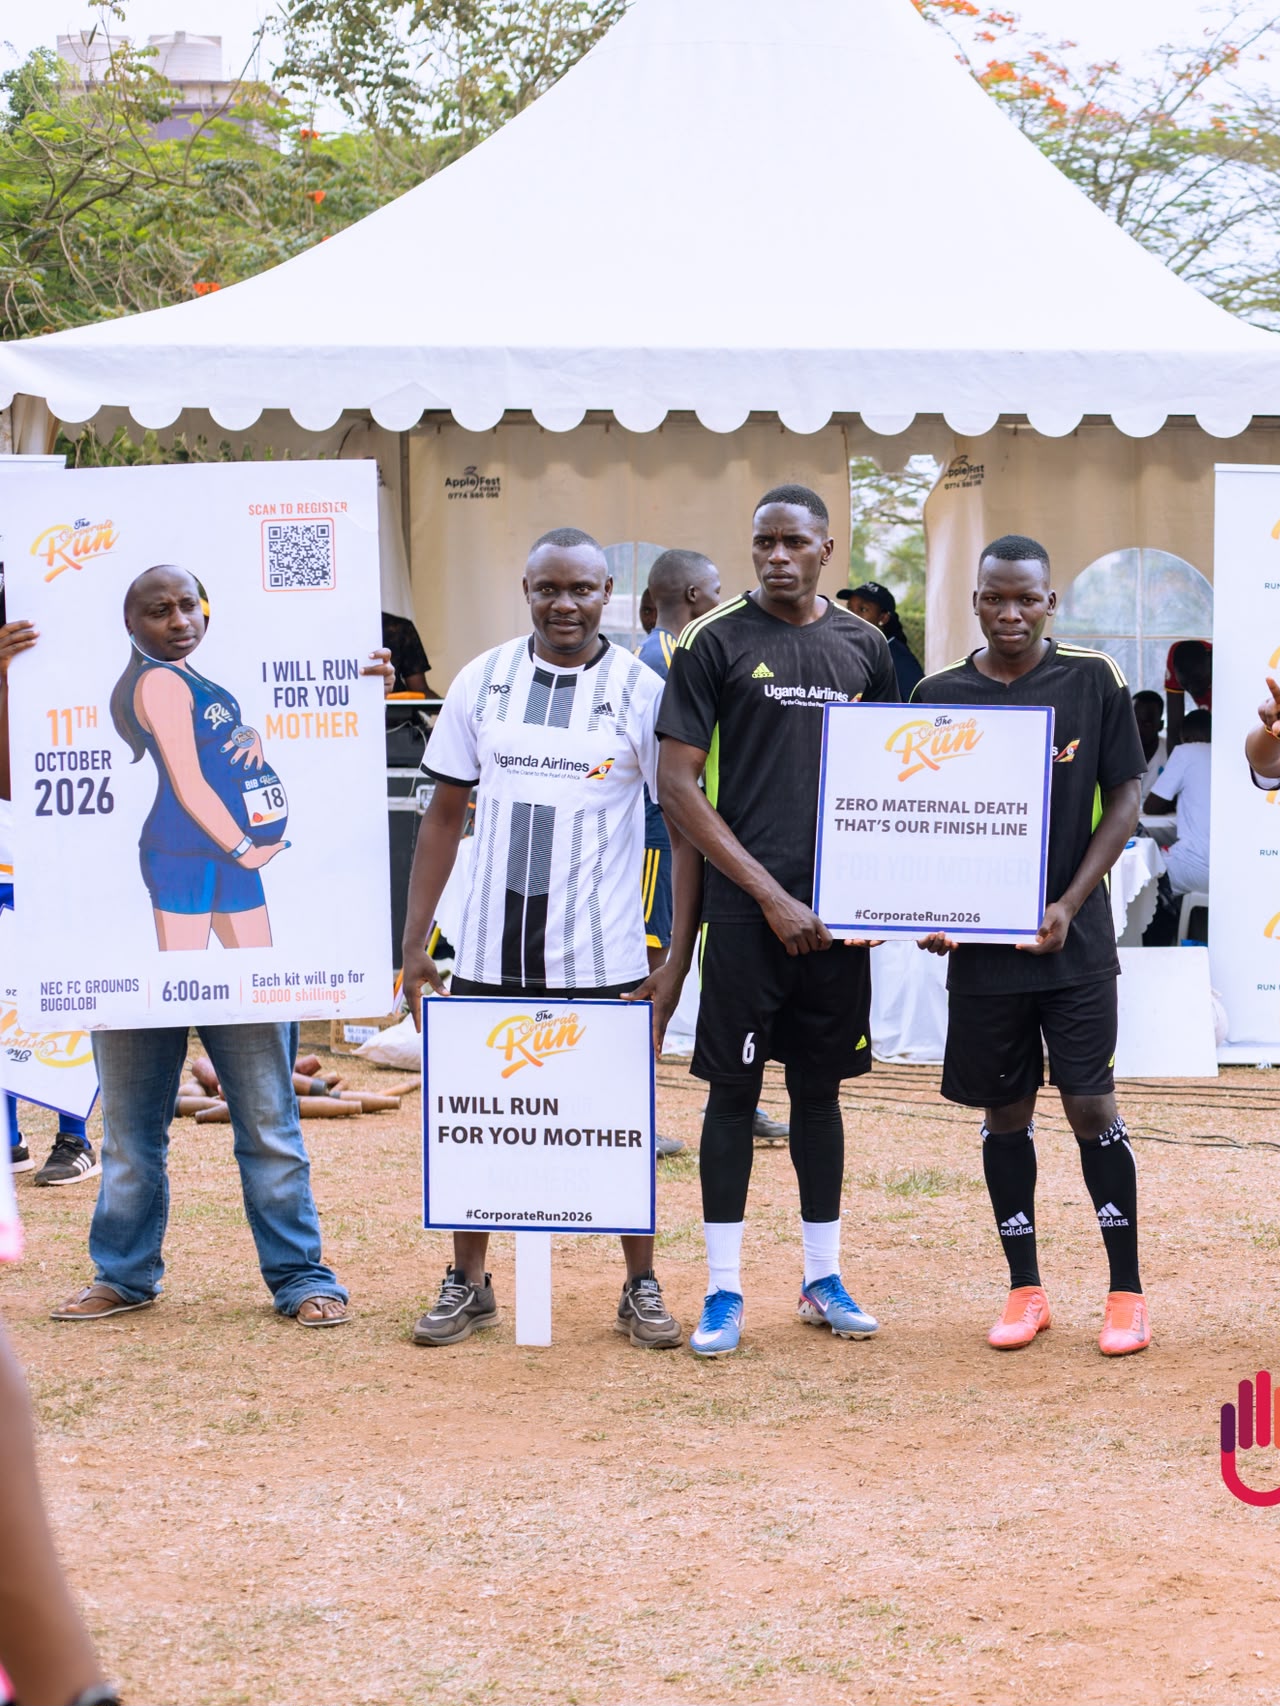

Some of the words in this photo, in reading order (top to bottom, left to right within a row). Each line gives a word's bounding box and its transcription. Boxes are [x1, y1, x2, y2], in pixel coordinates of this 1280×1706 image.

[248, 503, 278, 516] SCAN
[280, 503, 293, 515] TO
[297, 502, 348, 514] REGISTER
[29, 524, 120, 583] Run
[262, 662, 267, 683] I
[273, 660, 316, 682] WILL
[323, 658, 359, 681] RUN
[273, 687, 308, 708] FOR
[315, 685, 349, 706] YOU
[764, 684, 806, 700] Uganda
[807, 685, 849, 703] Airlines
[265, 711, 359, 740] MOTHER
[914, 718, 979, 739] Corporate
[934, 715, 952, 727] The
[884, 720, 984, 782] Run
[35, 750, 112, 772] OCTOBER
[494, 752, 539, 768] Uganda
[541, 756, 590, 773] Airlines
[244, 779, 259, 790] BIB
[35, 776, 115, 817] 2026
[262, 787, 285, 810] 18
[835, 797, 878, 811] ZERO
[882, 799, 970, 814] MATERNAL
[974, 801, 1028, 815] DEATH
[834, 818, 891, 833] THAT'S
[894, 820, 930, 833] OUR
[934, 821, 987, 836] FINISH
[991, 823, 1028, 836] LINE
[1260, 849, 1279, 857] RUN
[855, 909, 981, 924] #CorporateRun2026
[40, 982, 63, 995] NEC
[67, 981, 81, 994] FC
[85, 978, 140, 994] GROUNDS
[252, 972, 281, 988] Each
[285, 971, 300, 986] kit
[304, 971, 328, 986] will
[330, 975, 345, 989] go
[347, 970, 365, 984] for
[1257, 983, 1276, 991] RUN
[162, 980, 230, 1002] 6:00am
[252, 989, 291, 1004] 30,000
[295, 986, 347, 1004] shillings
[41, 996, 97, 1012] BUGOLOBI
[514, 1012, 580, 1035] Corporate
[535, 1010, 554, 1022] The
[485, 1015, 587, 1079] Run
[742, 1032, 755, 1064] 6
[438, 1096, 443, 1113] I
[449, 1096, 504, 1115] WILL
[510, 1098, 559, 1116] RUN
[438, 1126, 484, 1144] FOR
[488, 1127, 537, 1146] YOU
[543, 1128, 642, 1148] MOTHER
[466, 1209, 593, 1223] #CorporateRun2026
[1000, 1225, 1034, 1236] adidas
